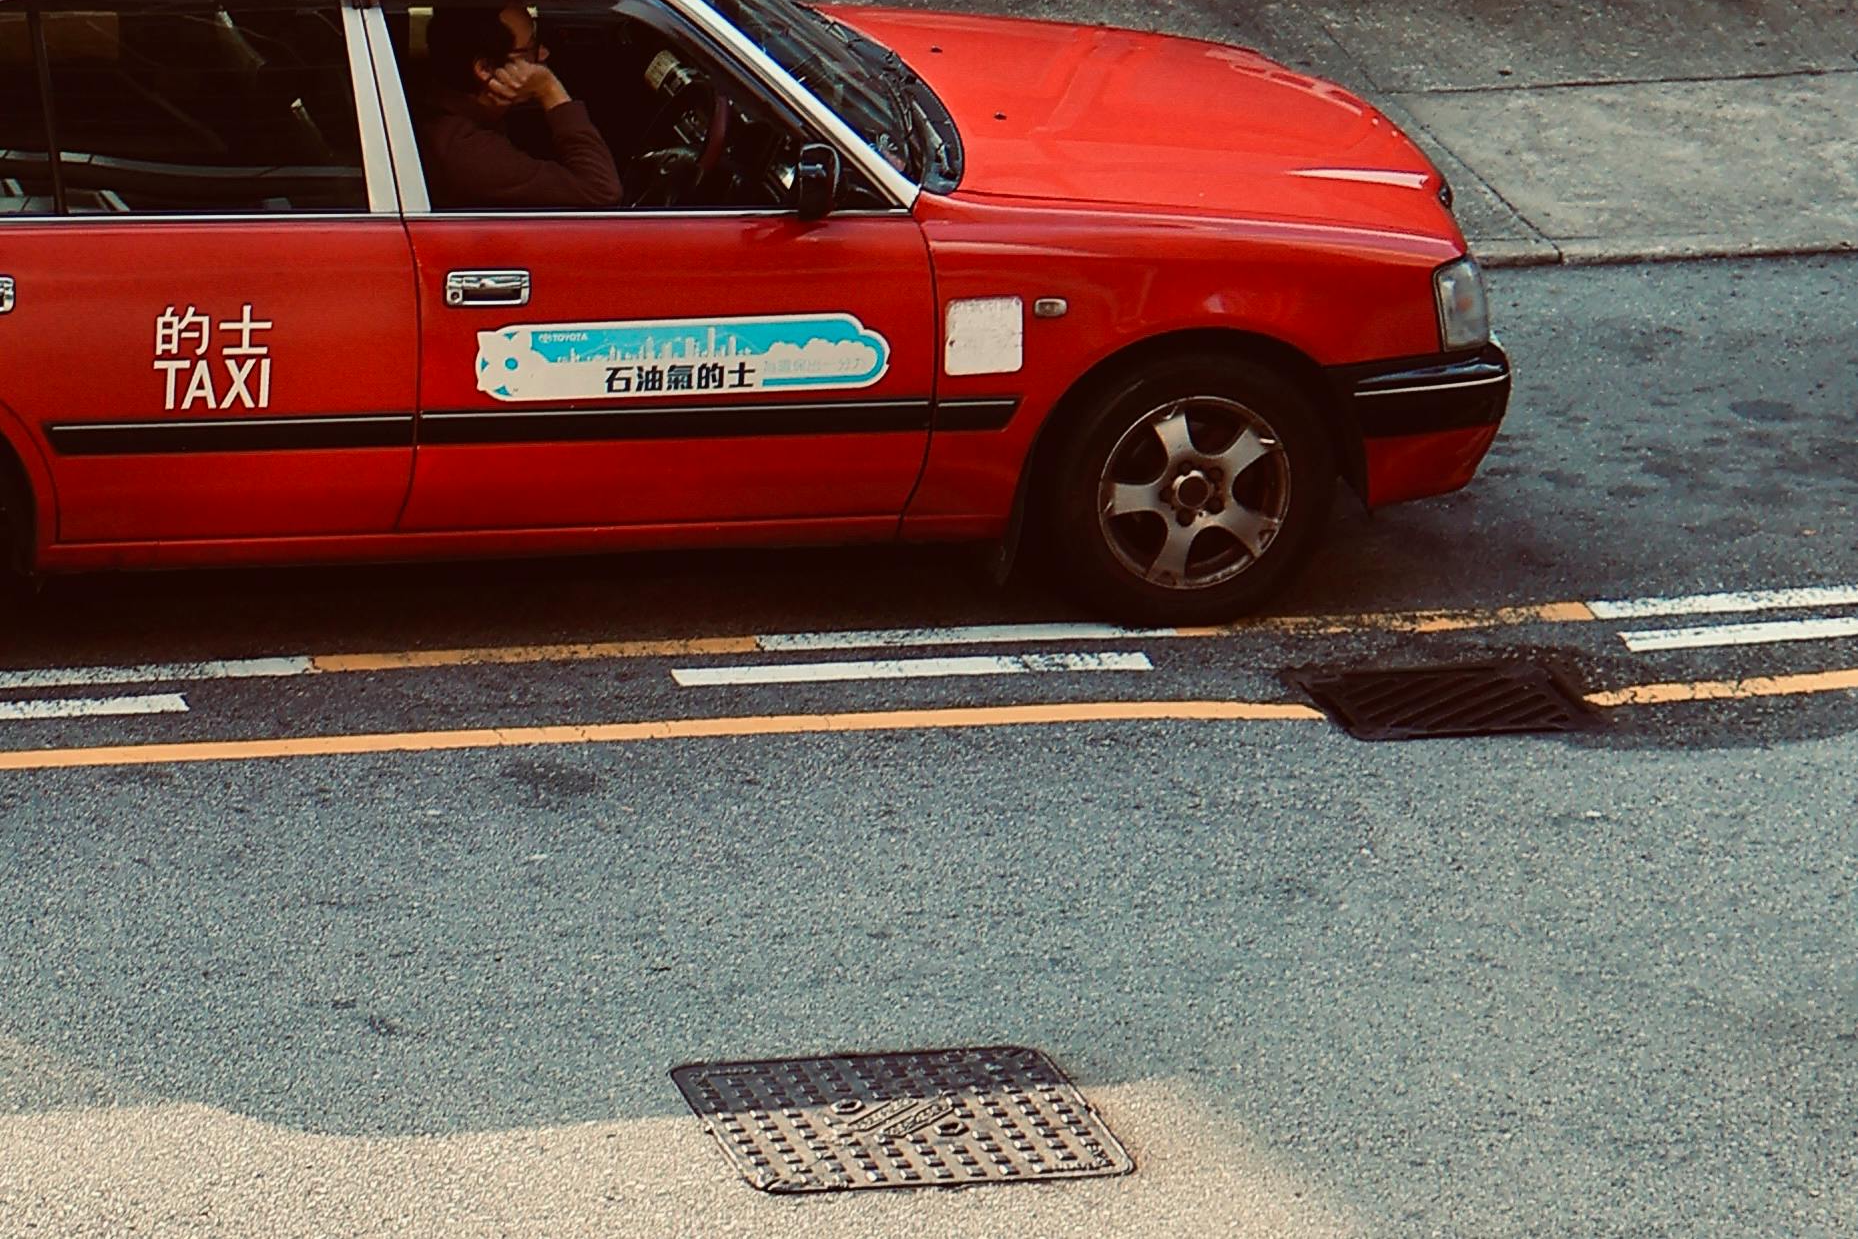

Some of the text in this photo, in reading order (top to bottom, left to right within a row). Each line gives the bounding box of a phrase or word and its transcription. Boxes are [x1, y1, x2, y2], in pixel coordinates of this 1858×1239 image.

[155, 305, 273, 356] 的士
[553, 332, 588, 342] TOYOTA
[153, 358, 271, 410] TAXI
[604, 361, 756, 394] 石油氣的士
